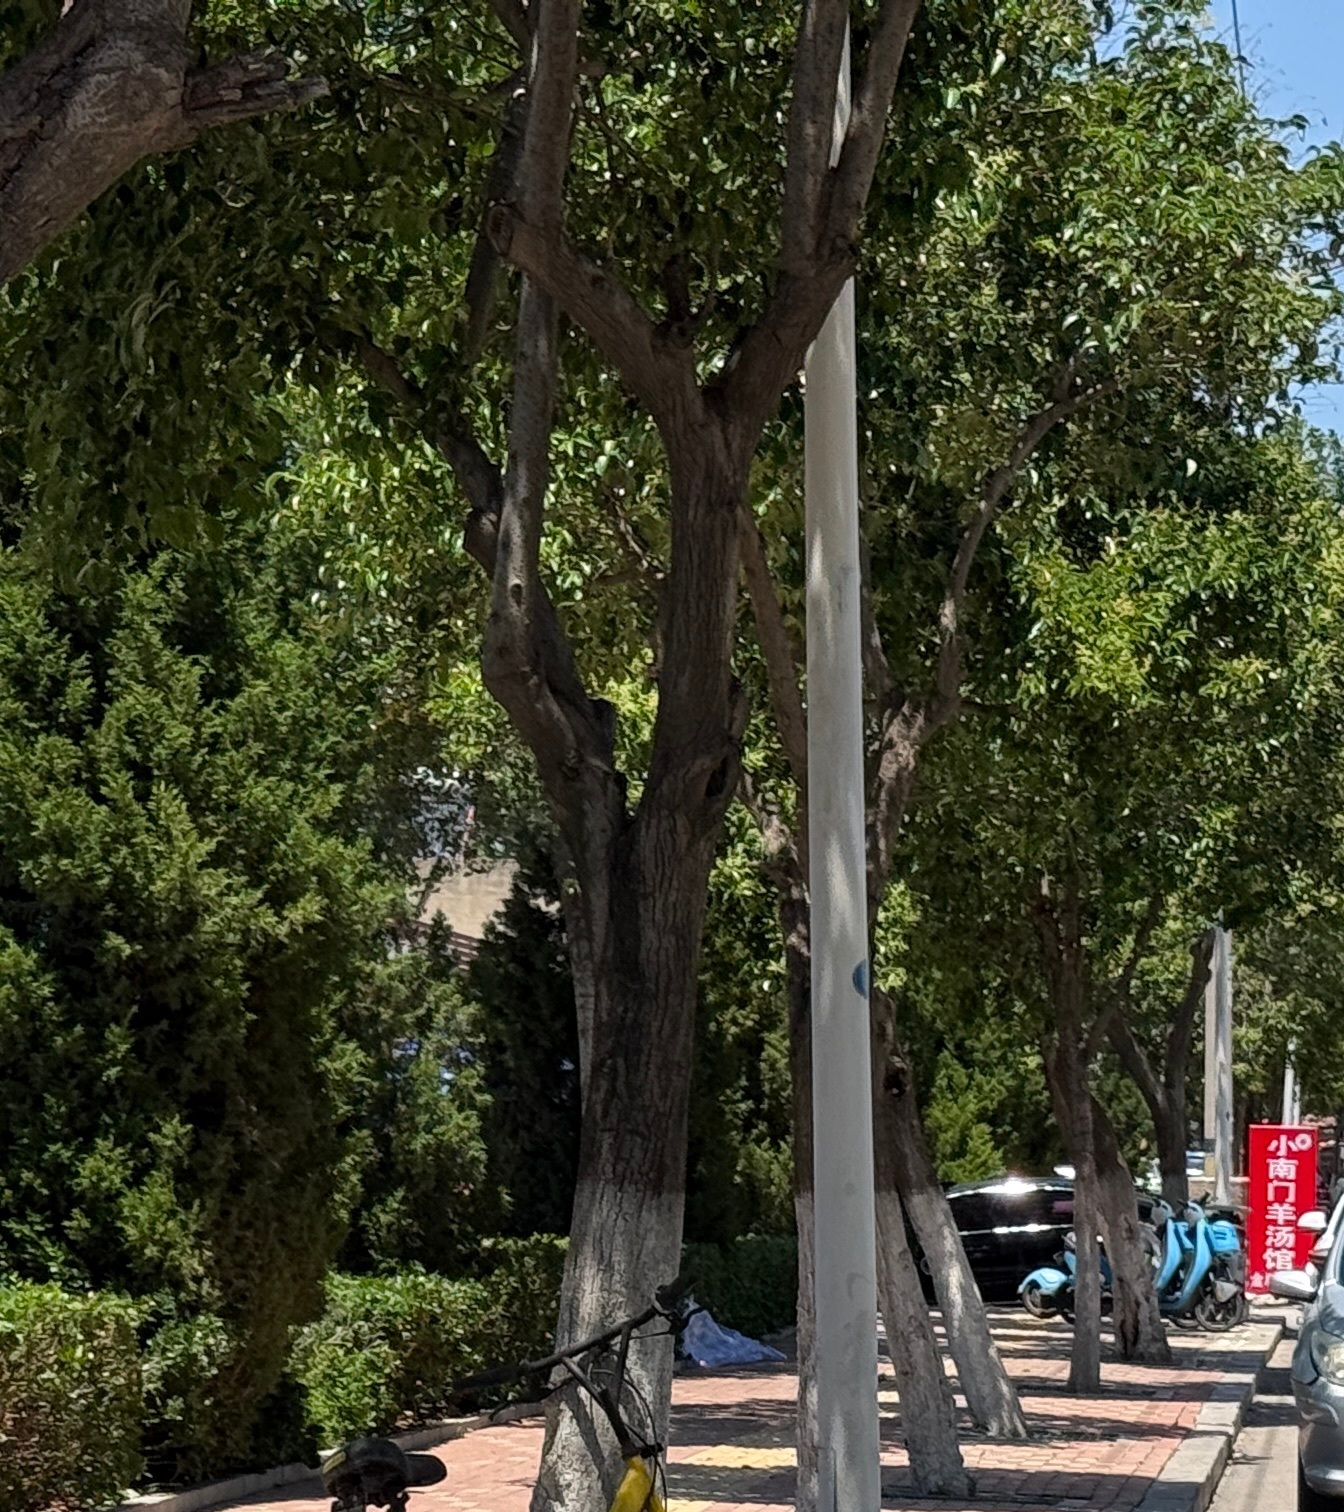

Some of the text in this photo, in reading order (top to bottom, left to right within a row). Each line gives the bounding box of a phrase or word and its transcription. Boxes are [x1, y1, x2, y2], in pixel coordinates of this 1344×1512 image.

[1262, 1134, 1299, 1271] 小南门羊汤馆
